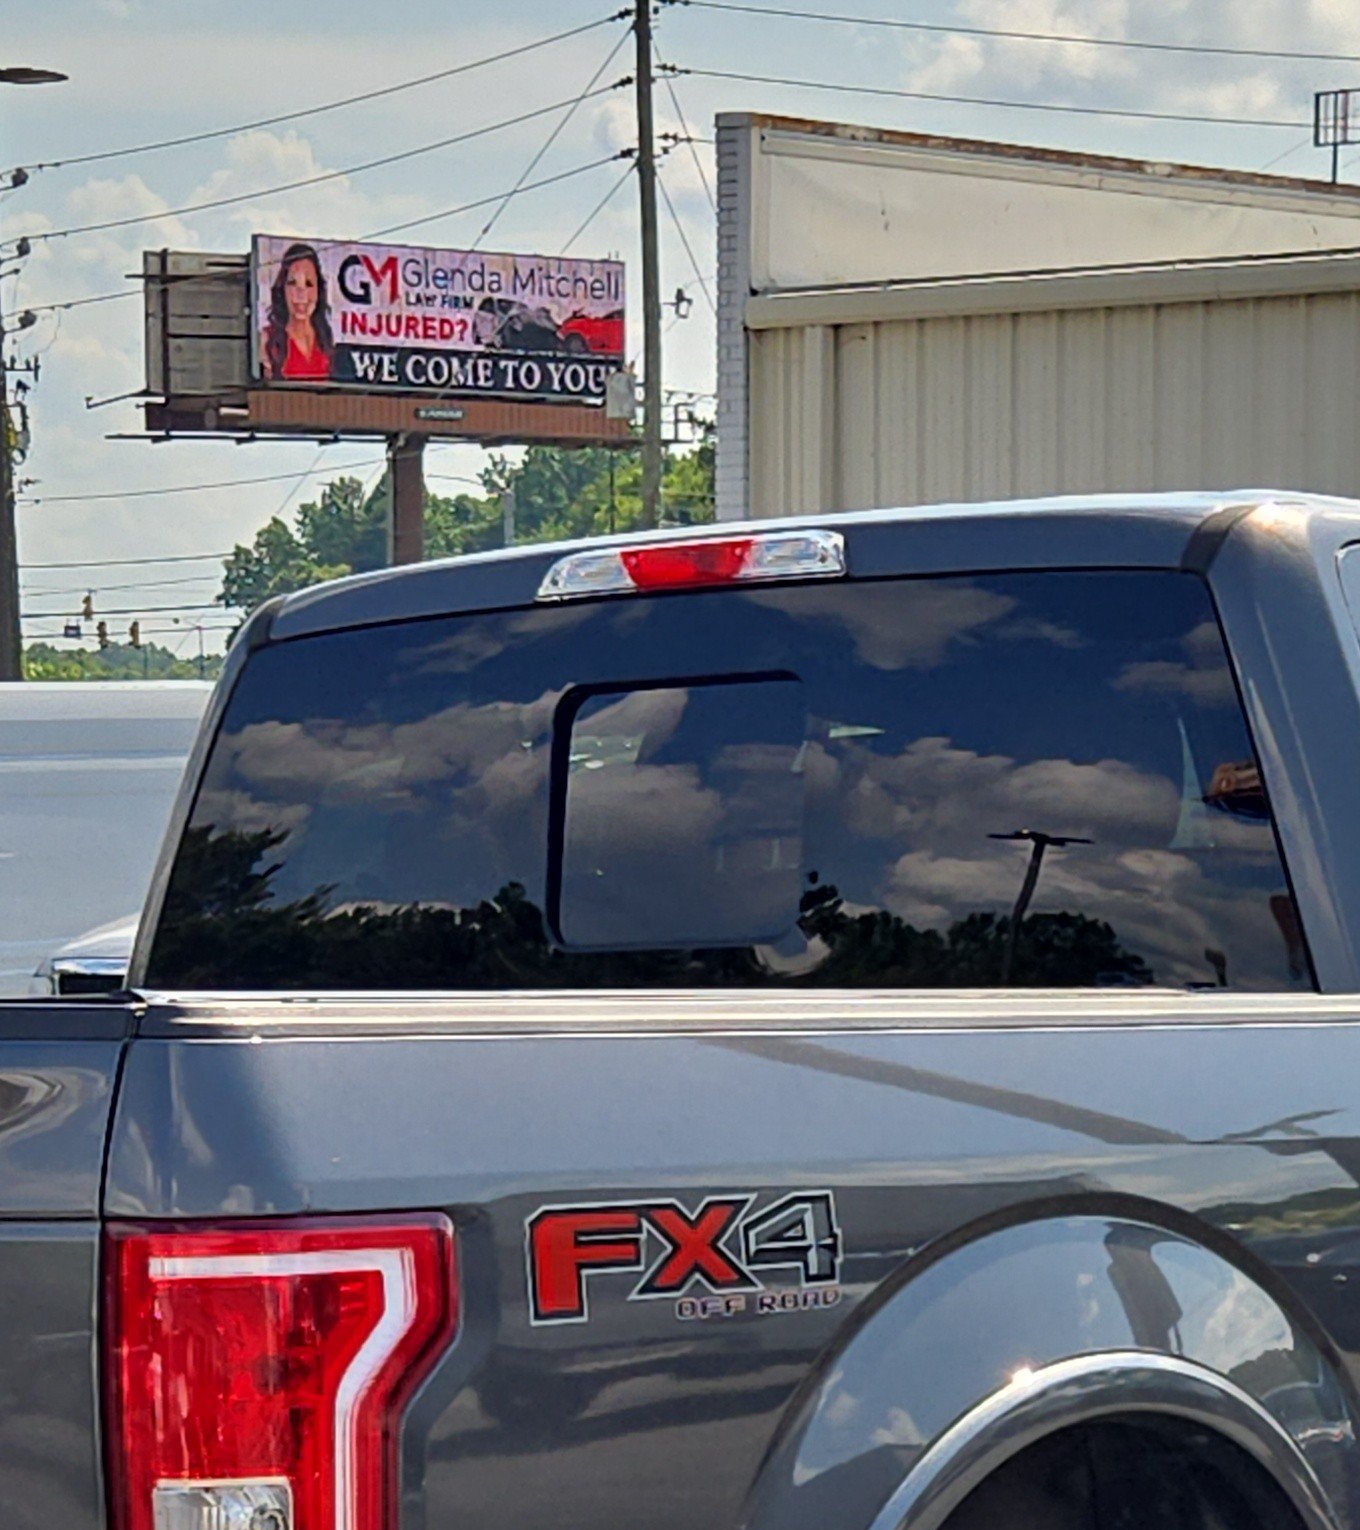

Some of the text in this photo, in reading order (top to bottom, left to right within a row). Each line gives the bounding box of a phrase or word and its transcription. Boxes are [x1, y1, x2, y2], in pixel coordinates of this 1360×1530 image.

[337, 254, 400, 305] GM
[402, 258, 620, 301] Glenda Mitchell
[405, 291, 474, 310] LAW FIRM
[341, 311, 469, 342] INJURED?
[350, 352, 617, 394] WE COME TO YOU
[524, 1190, 842, 1327] FX4
[675, 1289, 840, 1321] OFF ROAD
